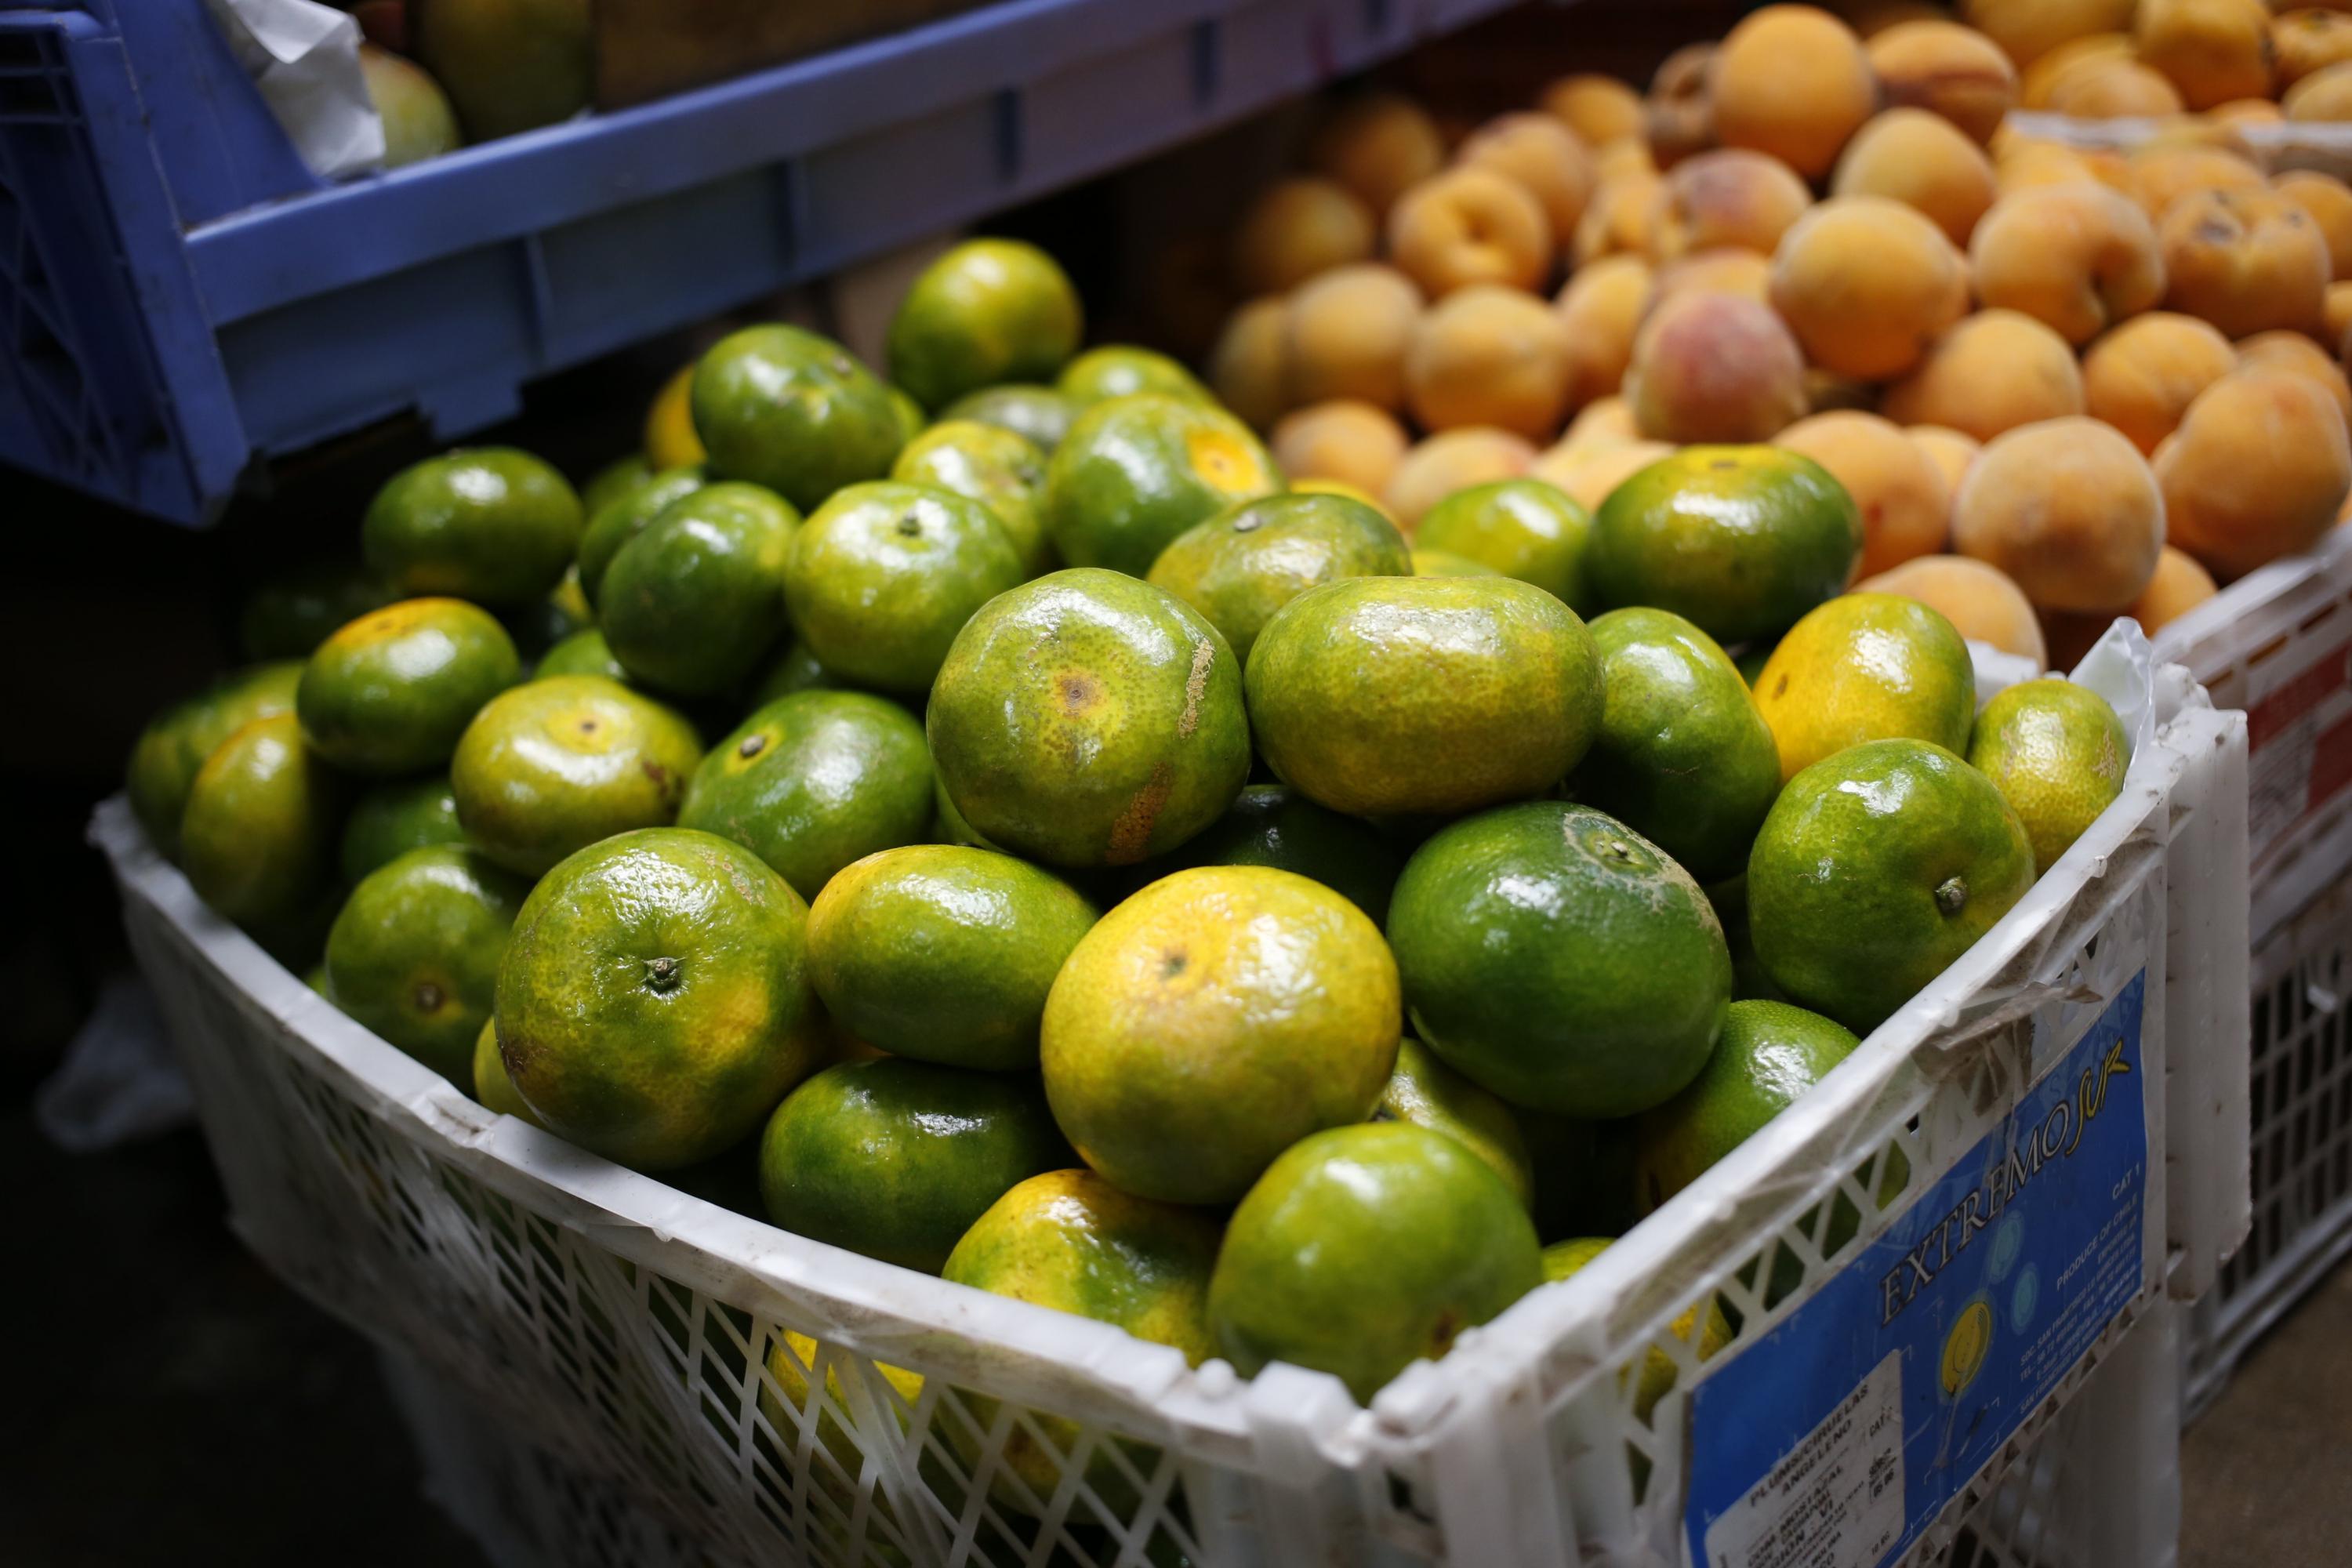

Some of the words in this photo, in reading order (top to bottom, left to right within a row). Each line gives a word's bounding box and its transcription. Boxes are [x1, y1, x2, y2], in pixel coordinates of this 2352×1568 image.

[2112, 1171, 2131, 1200] CAT
[2056, 1236, 2097, 1289] PRODUCE
[2100, 1221, 2111, 1240] OF
